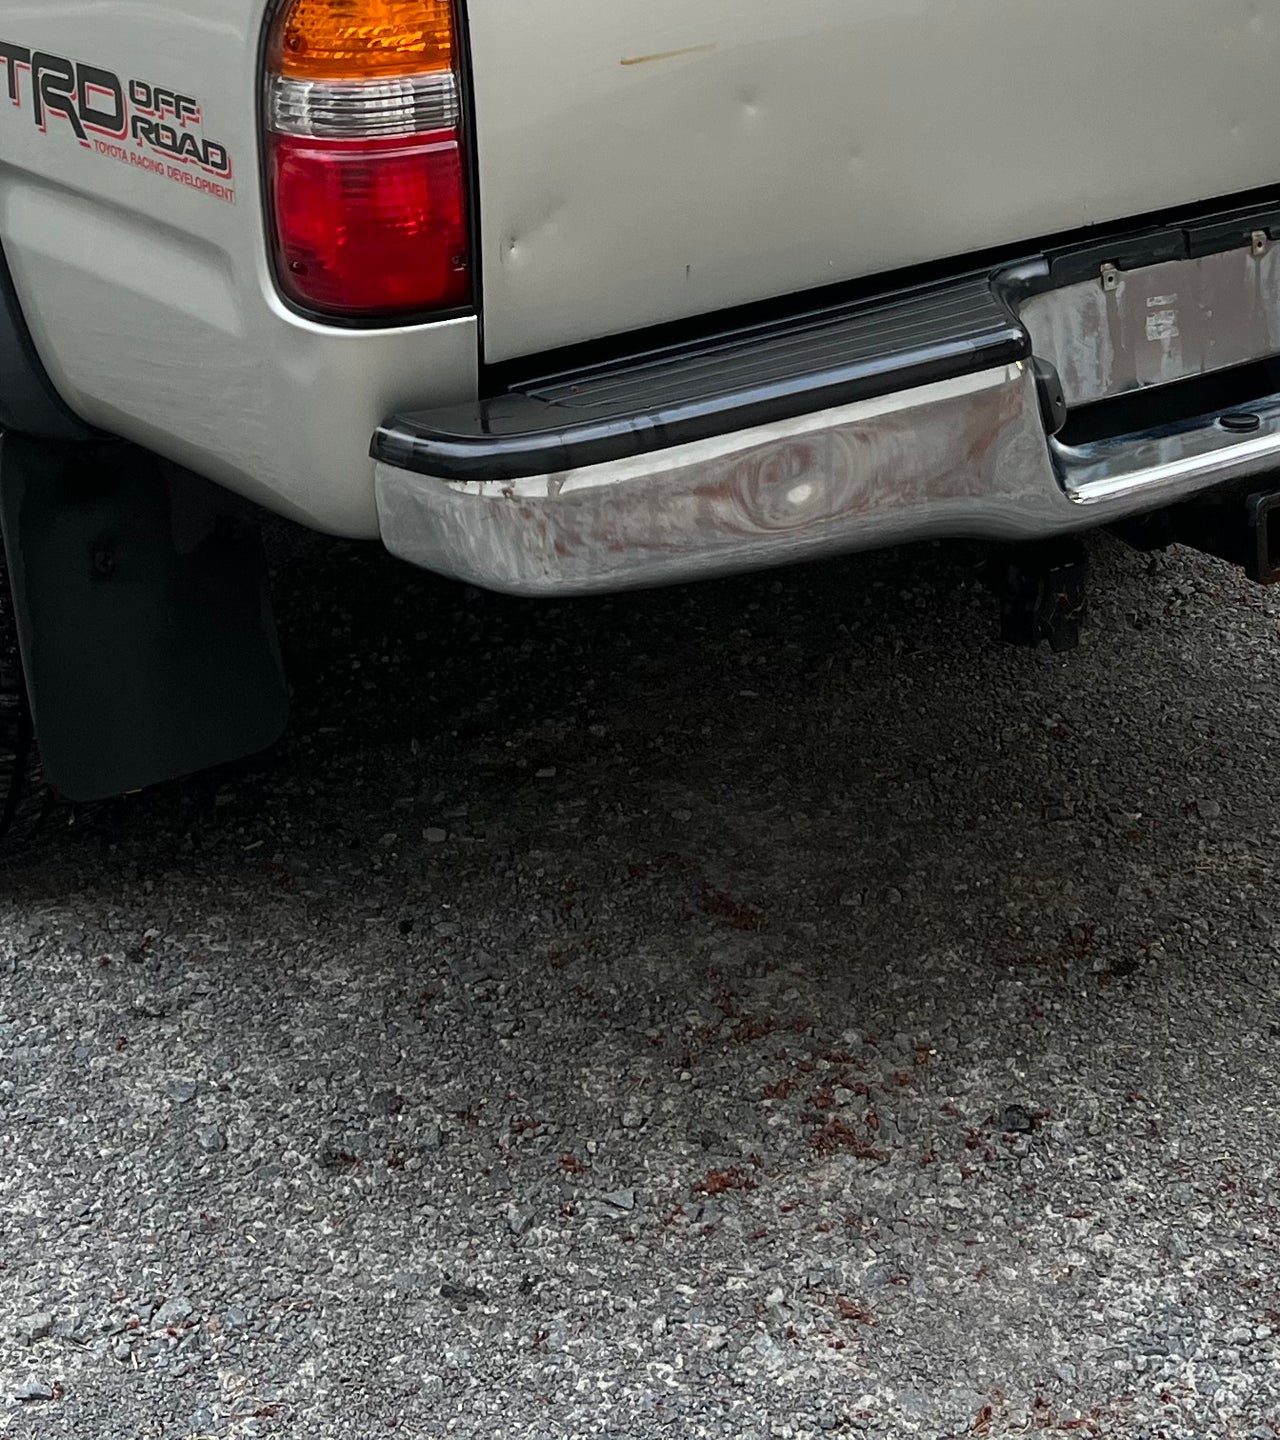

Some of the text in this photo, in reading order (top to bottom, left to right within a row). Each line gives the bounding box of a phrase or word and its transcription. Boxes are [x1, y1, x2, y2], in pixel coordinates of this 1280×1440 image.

[129, 79, 201, 127] OFF
[94, 139, 233, 202] TOYOTA RACING DEVELOPMENT
[131, 114, 232, 179] ROAD
